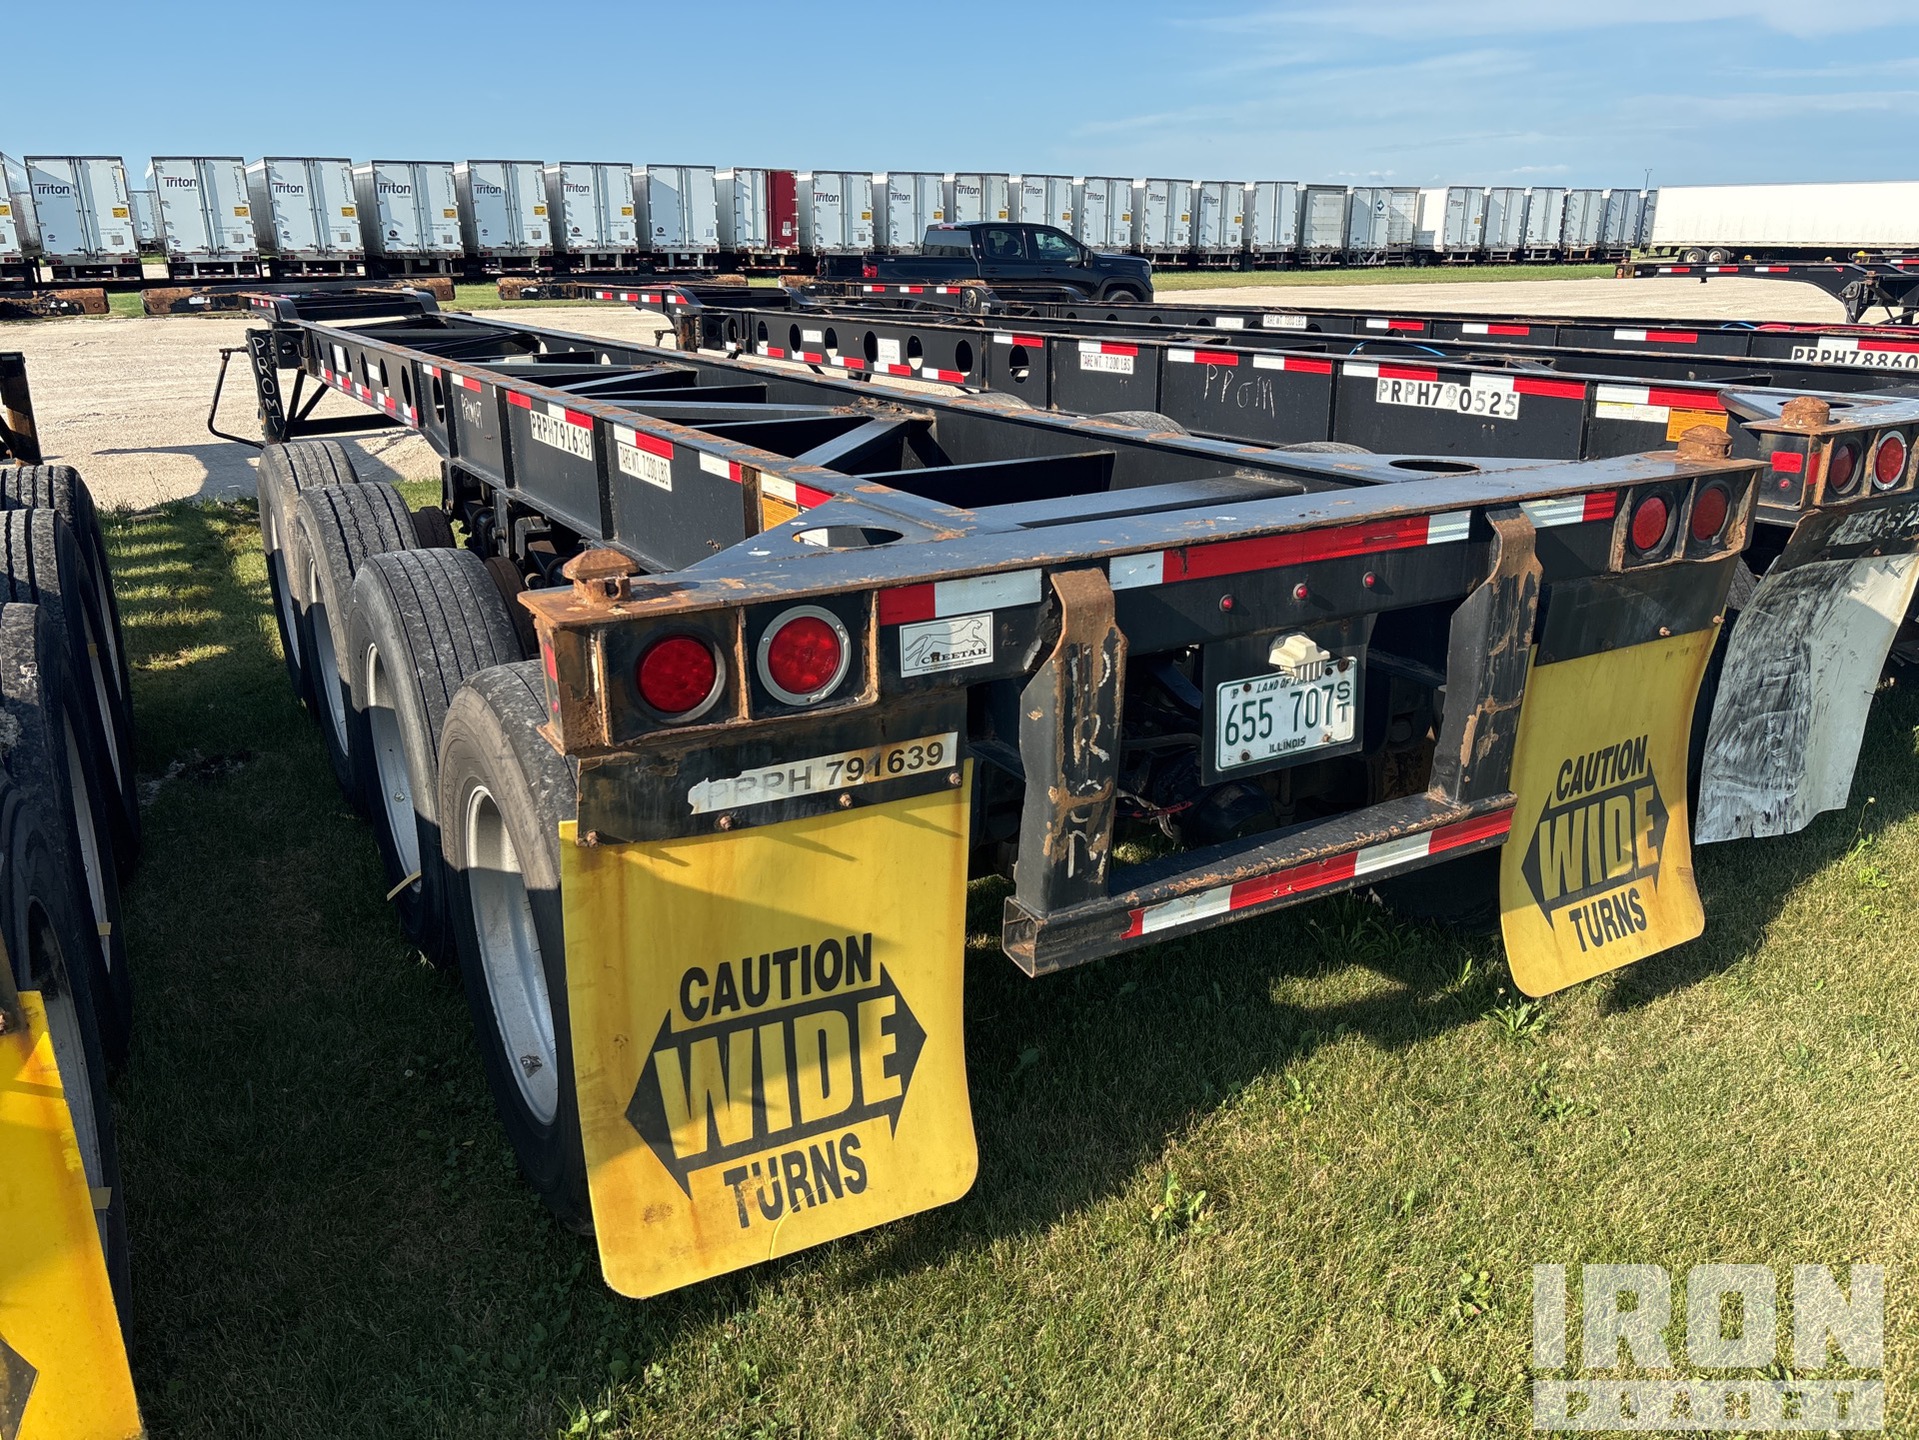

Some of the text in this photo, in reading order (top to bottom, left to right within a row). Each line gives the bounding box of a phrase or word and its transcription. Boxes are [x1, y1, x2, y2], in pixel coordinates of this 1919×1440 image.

[34, 183, 70, 195] Triton
[162, 176, 197, 188] Triton
[272, 182, 304, 193] Triton
[378, 182, 411, 194] Triton
[473, 184, 502, 194] Triton
[563, 183, 590, 193] Triton
[890, 192, 911, 201] Triton
[957, 185, 980, 195] Triton
[1024, 185, 1043, 195] Triton
[1086, 192, 1105, 201] Triton
[813, 192, 839, 203] Triton
[1148, 193, 1166, 203] Triton
[1378, 379, 1517, 416] PRPH790525
[531, 413, 591, 458] PRPH791639
[1256, 680, 1279, 693] LAND
[1279, 677, 1290, 688] OF
[1225, 684, 1335, 746] 655 707
[1269, 735, 1307, 754] ILLINOIS
[825, 741, 945, 787] 791639
[1556, 734, 1649, 802] CAUTION
[1538, 785, 1659, 901] WIDE
[1569, 887, 1647, 952] TURNS
[679, 932, 872, 1022] CAUTION
[653, 994, 903, 1159] WIDE
[723, 1132, 868, 1228] TURNS
